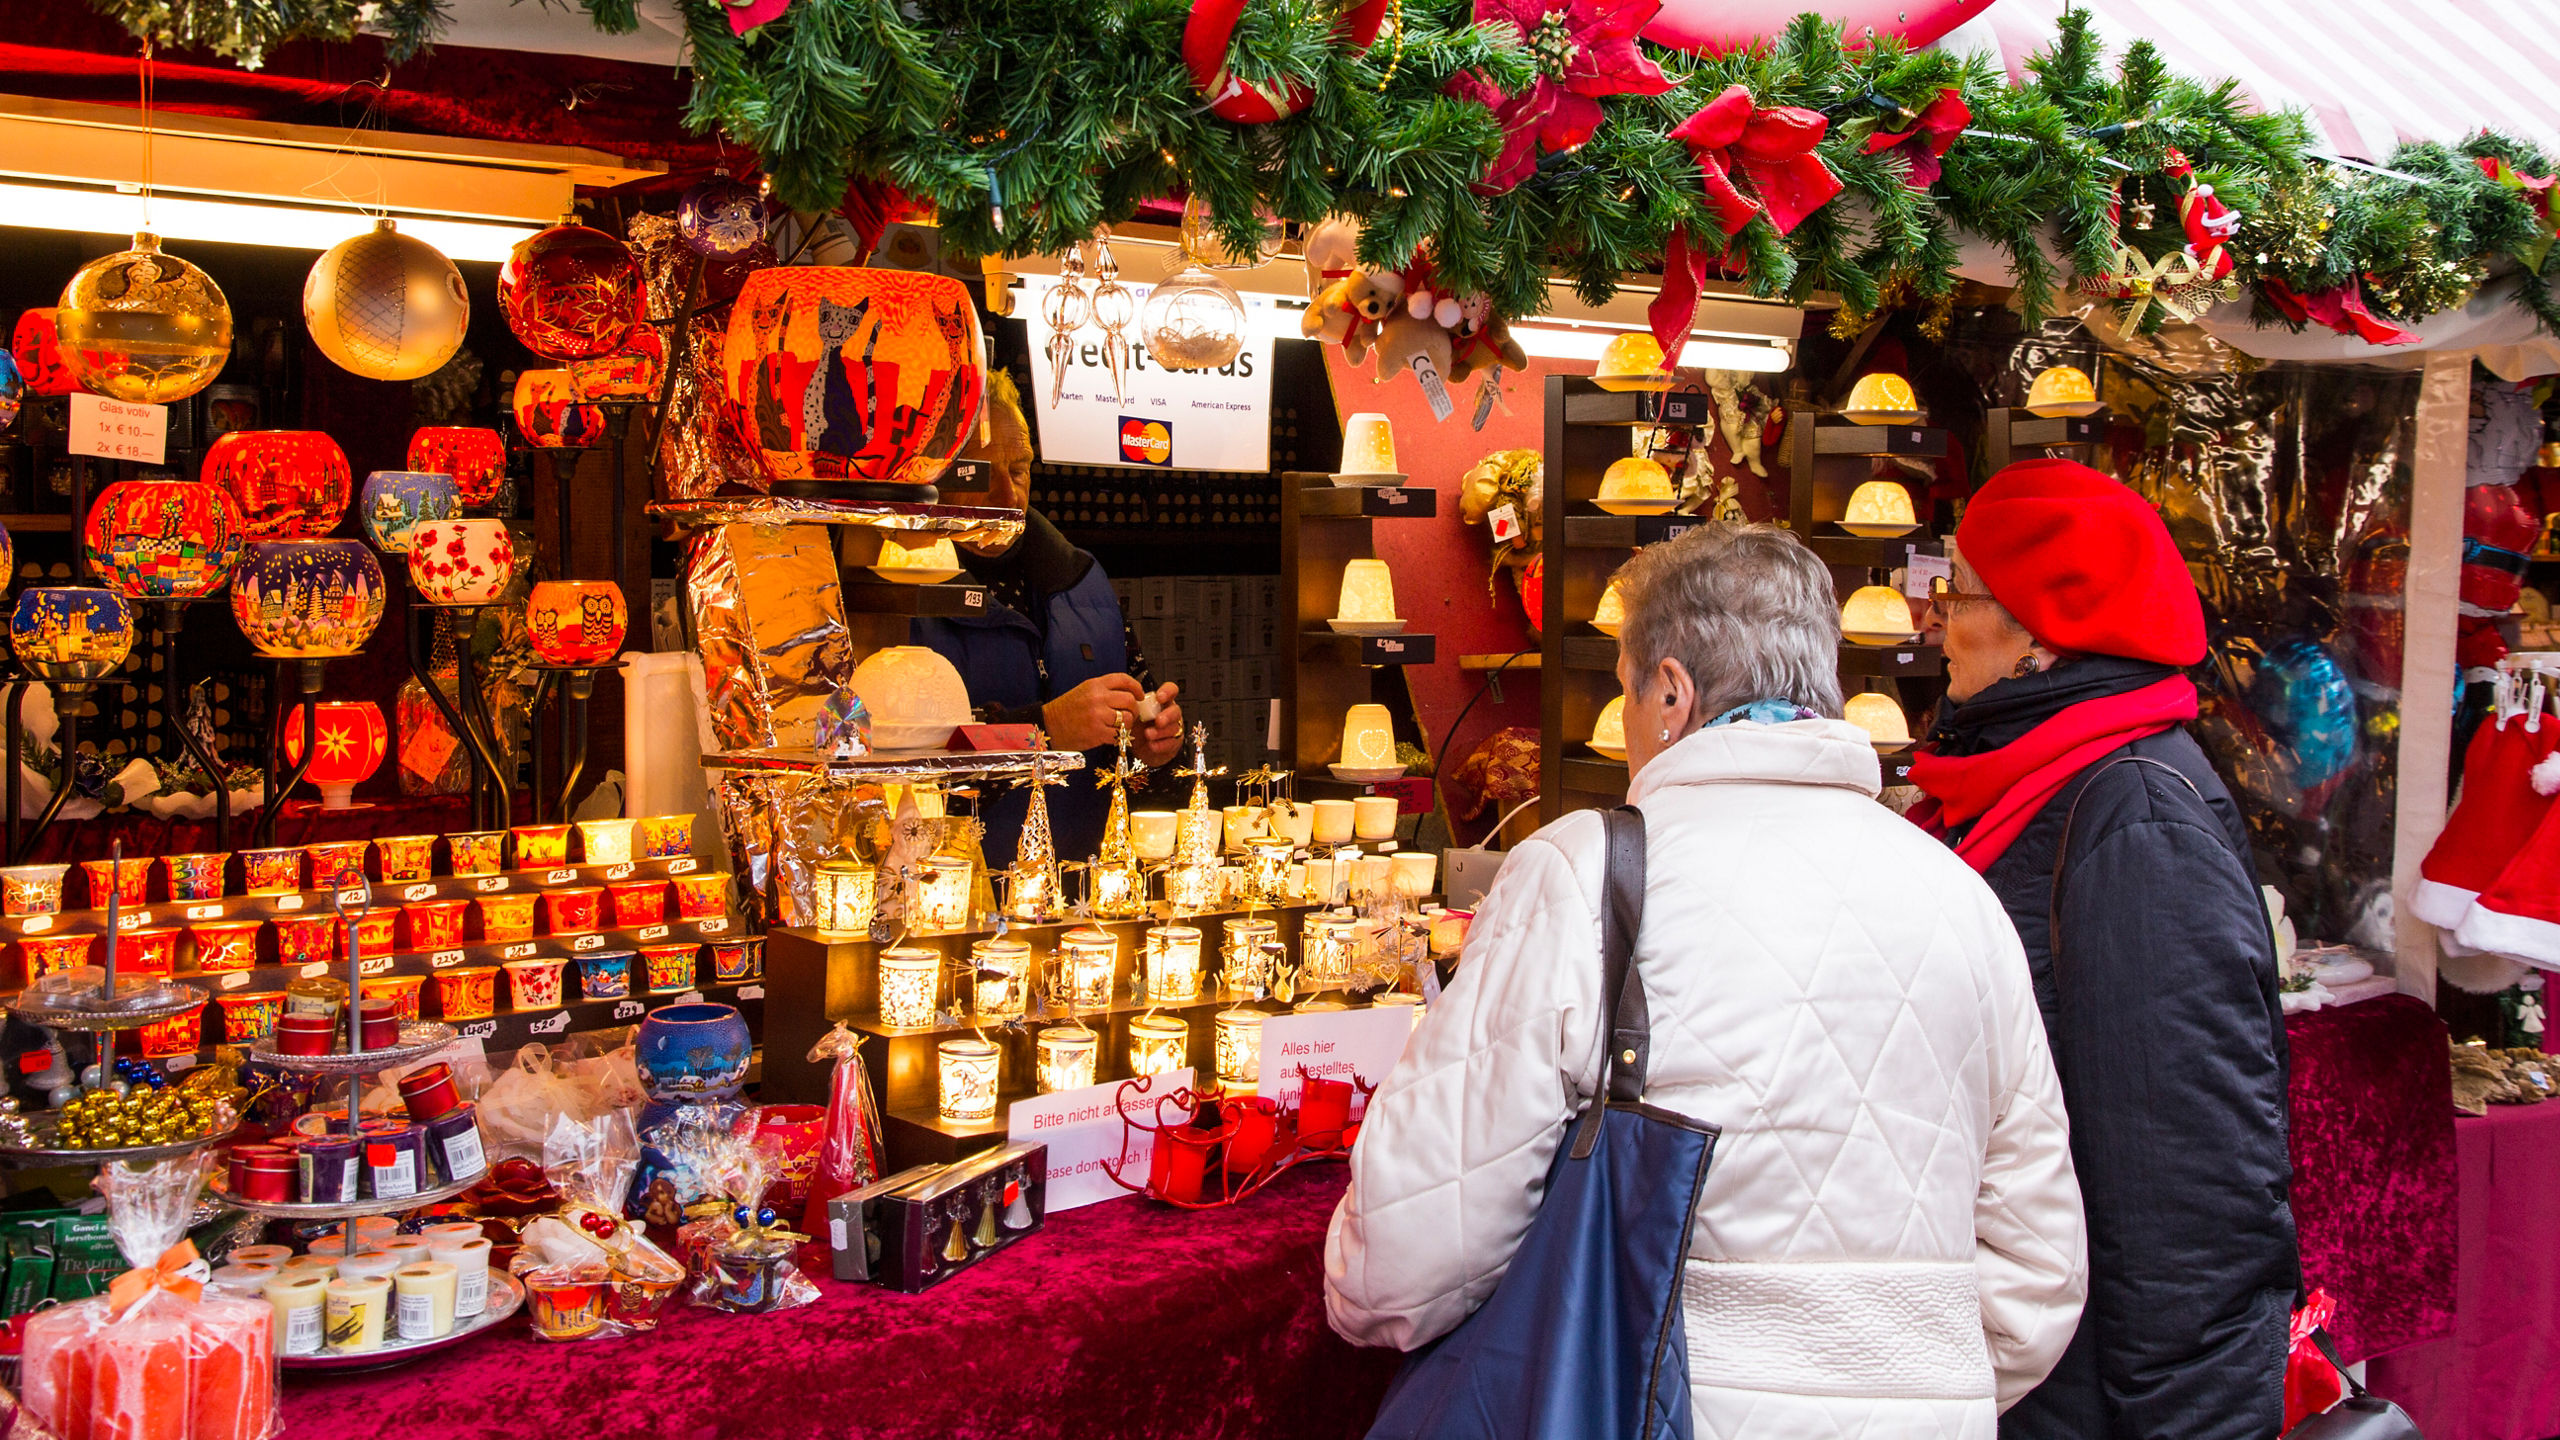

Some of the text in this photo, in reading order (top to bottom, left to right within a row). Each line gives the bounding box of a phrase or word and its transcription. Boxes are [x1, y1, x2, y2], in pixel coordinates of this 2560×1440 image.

[1061, 391, 1251, 412] Karten Masterard VISA American Express
[99, 401, 151, 418] Glas votiv
[99, 422, 111, 432] 1x
[97, 442, 110, 453] 2x
[1122, 433, 1169, 450] MasterCard
[966, 592, 981, 605] 193
[551, 869, 571, 880] 123
[609, 864, 631, 878] 143
[345, 891, 363, 901] 12
[701, 919, 720, 932] 306
[362, 959, 386, 971] 211
[437, 952, 459, 965] 226
[618, 1005, 638, 1017] 829
[467, 1022, 493, 1035] 404
[533, 1019, 556, 1032] 520
[1281, 1040, 1335, 1056] Alles hier
[1280, 1061, 1355, 1079] ausestelltes
[1033, 1114, 1064, 1130] Bitte
[1068, 1105, 1099, 1124] nicht
[1046, 1165, 1073, 1180] ease
[1107, 1150, 1140, 1168] toch
